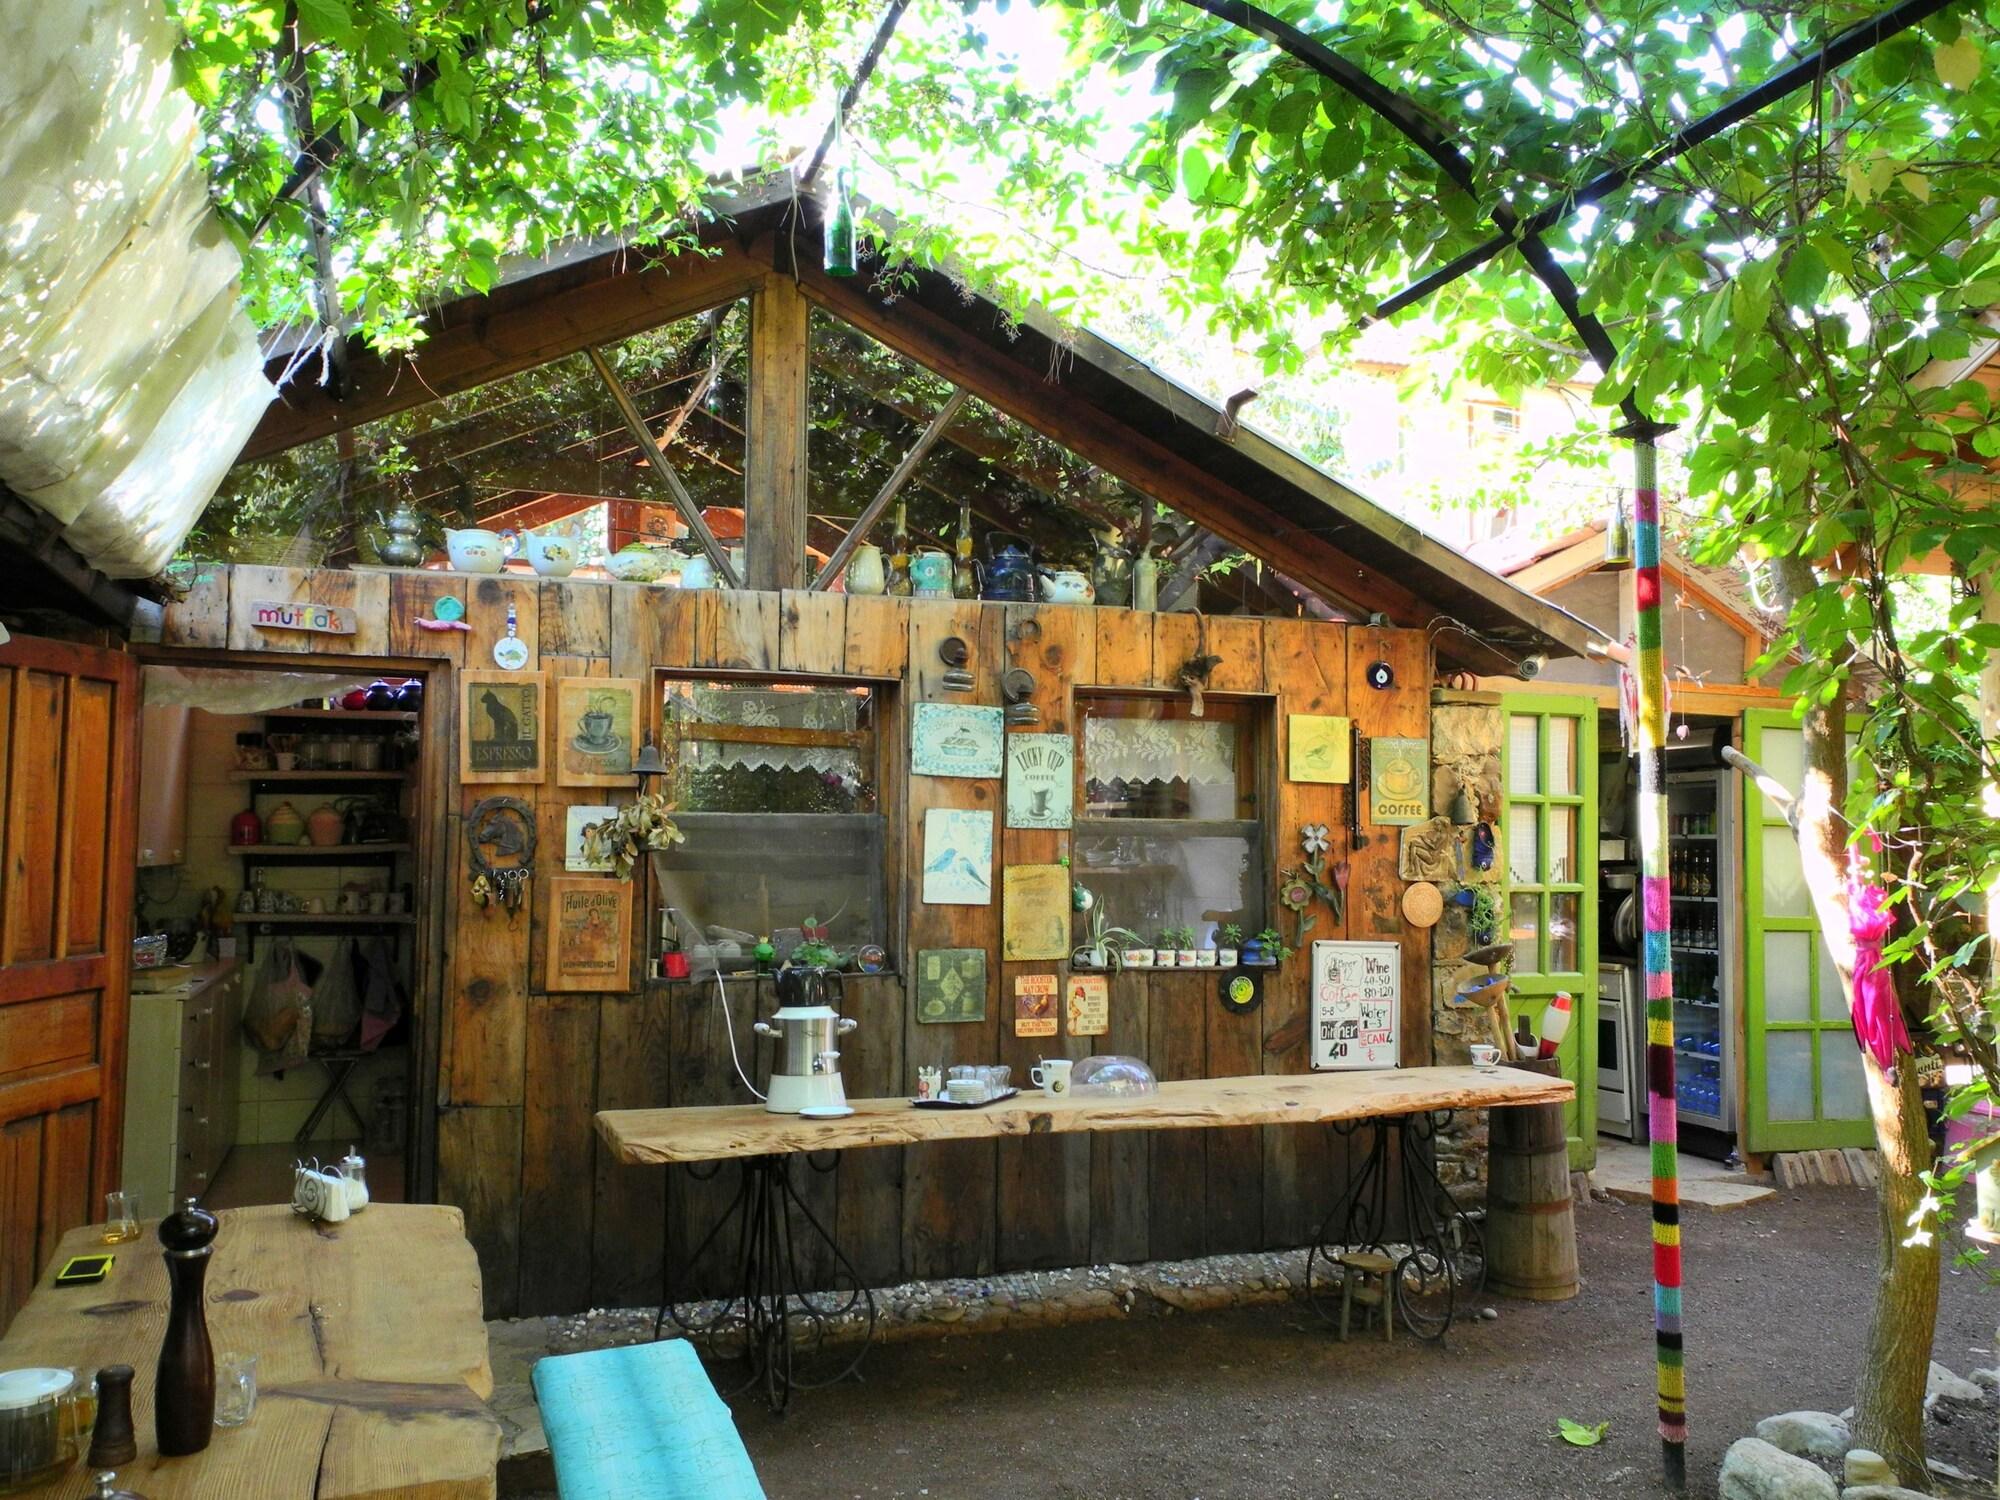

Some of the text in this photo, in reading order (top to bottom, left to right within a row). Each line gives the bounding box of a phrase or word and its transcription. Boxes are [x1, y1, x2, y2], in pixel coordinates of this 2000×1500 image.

[258, 607, 340, 630] mutfak
[475, 745, 533, 761] ESPRESSO
[1015, 746, 1065, 772] LUCKY CUP
[1378, 804, 1422, 816] COFFEE
[565, 894, 590, 912] Huile
[1365, 957, 1390, 975] Wine
[1360, 1001, 1388, 1019] Water
[1328, 1042, 1348, 1060] 40
